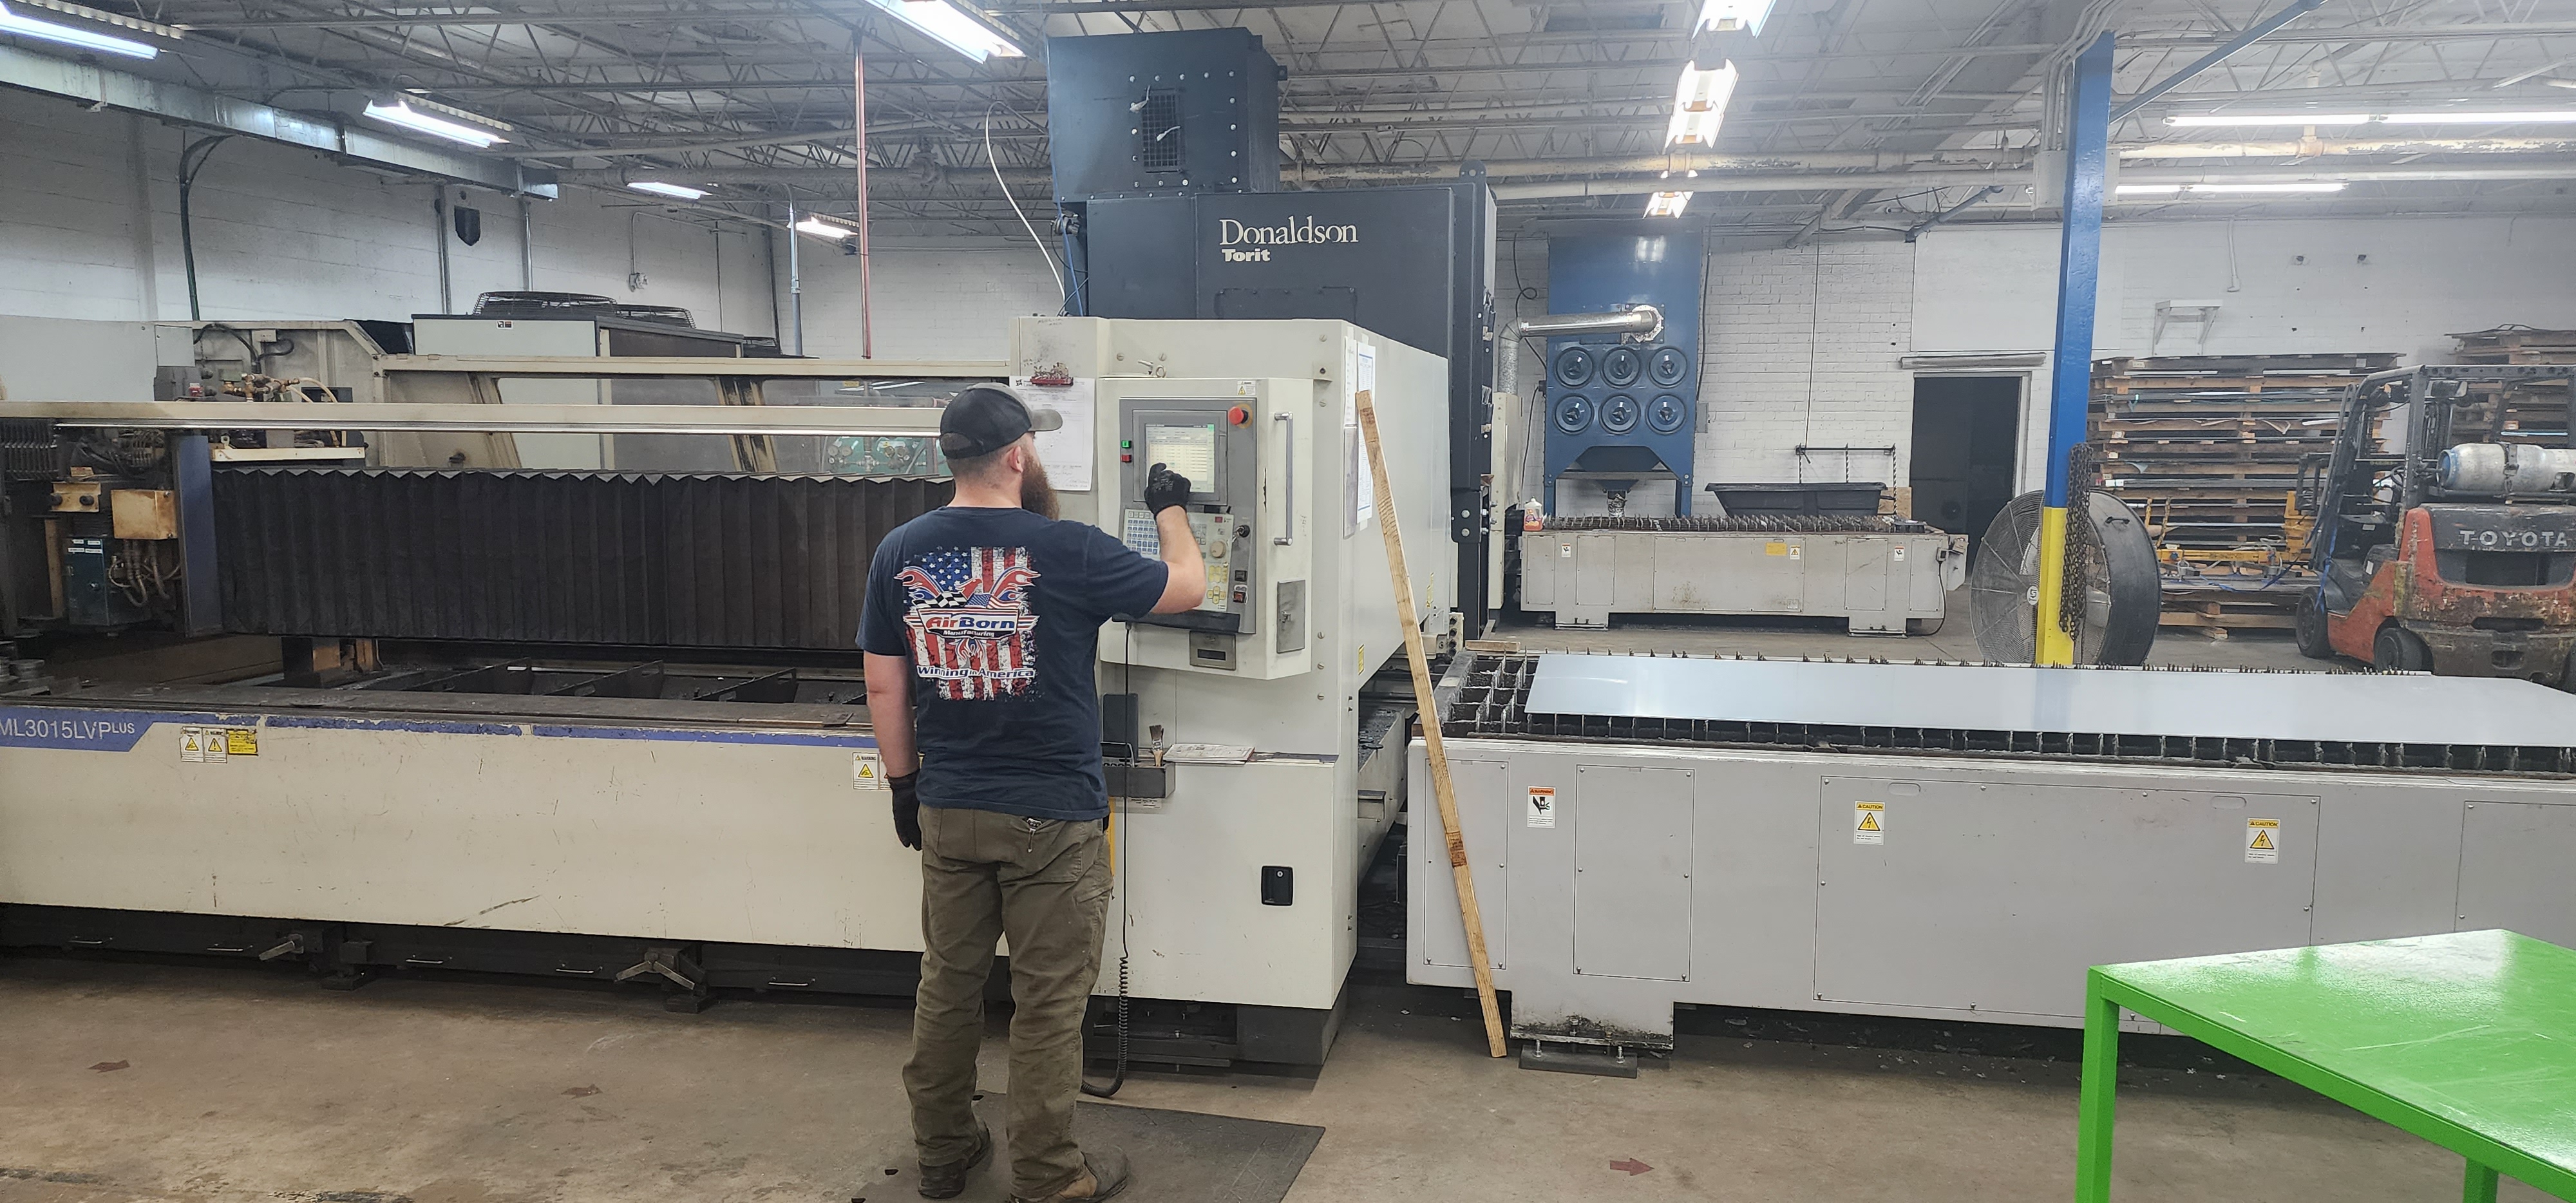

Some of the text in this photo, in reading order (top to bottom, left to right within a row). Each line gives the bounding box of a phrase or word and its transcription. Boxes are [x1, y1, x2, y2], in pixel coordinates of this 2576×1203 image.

[1219, 215, 1359, 245] Donaldson
[1222, 248, 1271, 261] Torit
[2459, 530, 2568, 547] TOYOTA
[925, 616, 1015, 629] AirBorn
[943, 629, 995, 638] Manufacturing
[918, 667, 967, 676] Winning
[980, 667, 1034, 677] America
